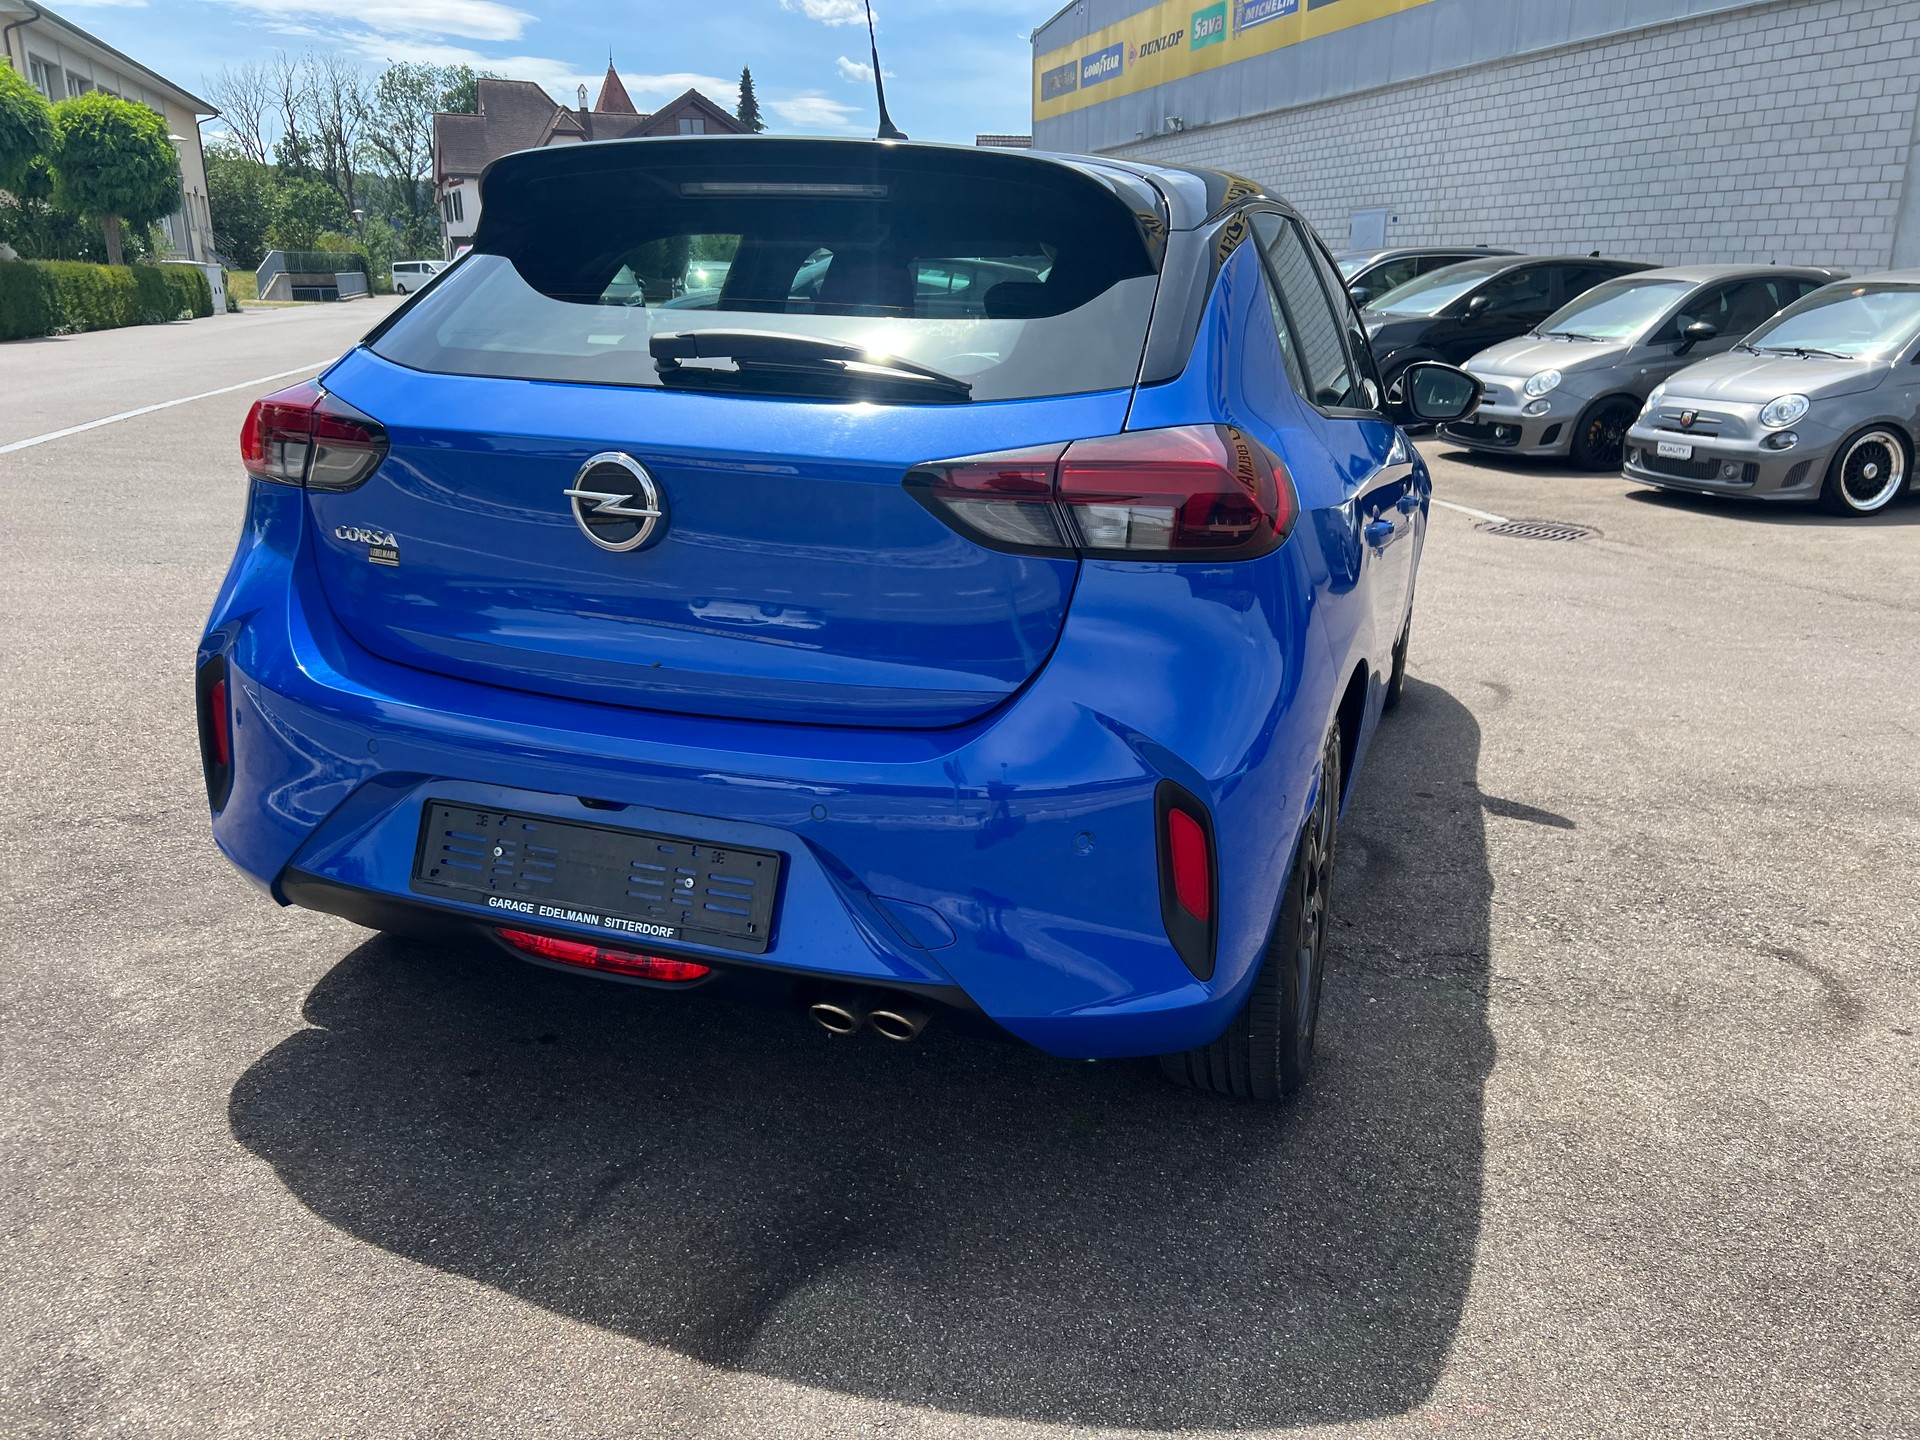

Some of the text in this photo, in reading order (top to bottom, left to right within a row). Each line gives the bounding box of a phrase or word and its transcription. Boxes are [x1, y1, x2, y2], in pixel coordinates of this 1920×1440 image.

[1193, 15, 1223, 40] Sava
[1139, 30, 1184, 58] DUNLOP
[1083, 54, 1120, 79] GOODYEAR
[1660, 445, 1686, 454] QUALITY
[335, 525, 399, 548] CORSA
[488, 896, 675, 938] GARAGE EDELMANN SITTERDORF
